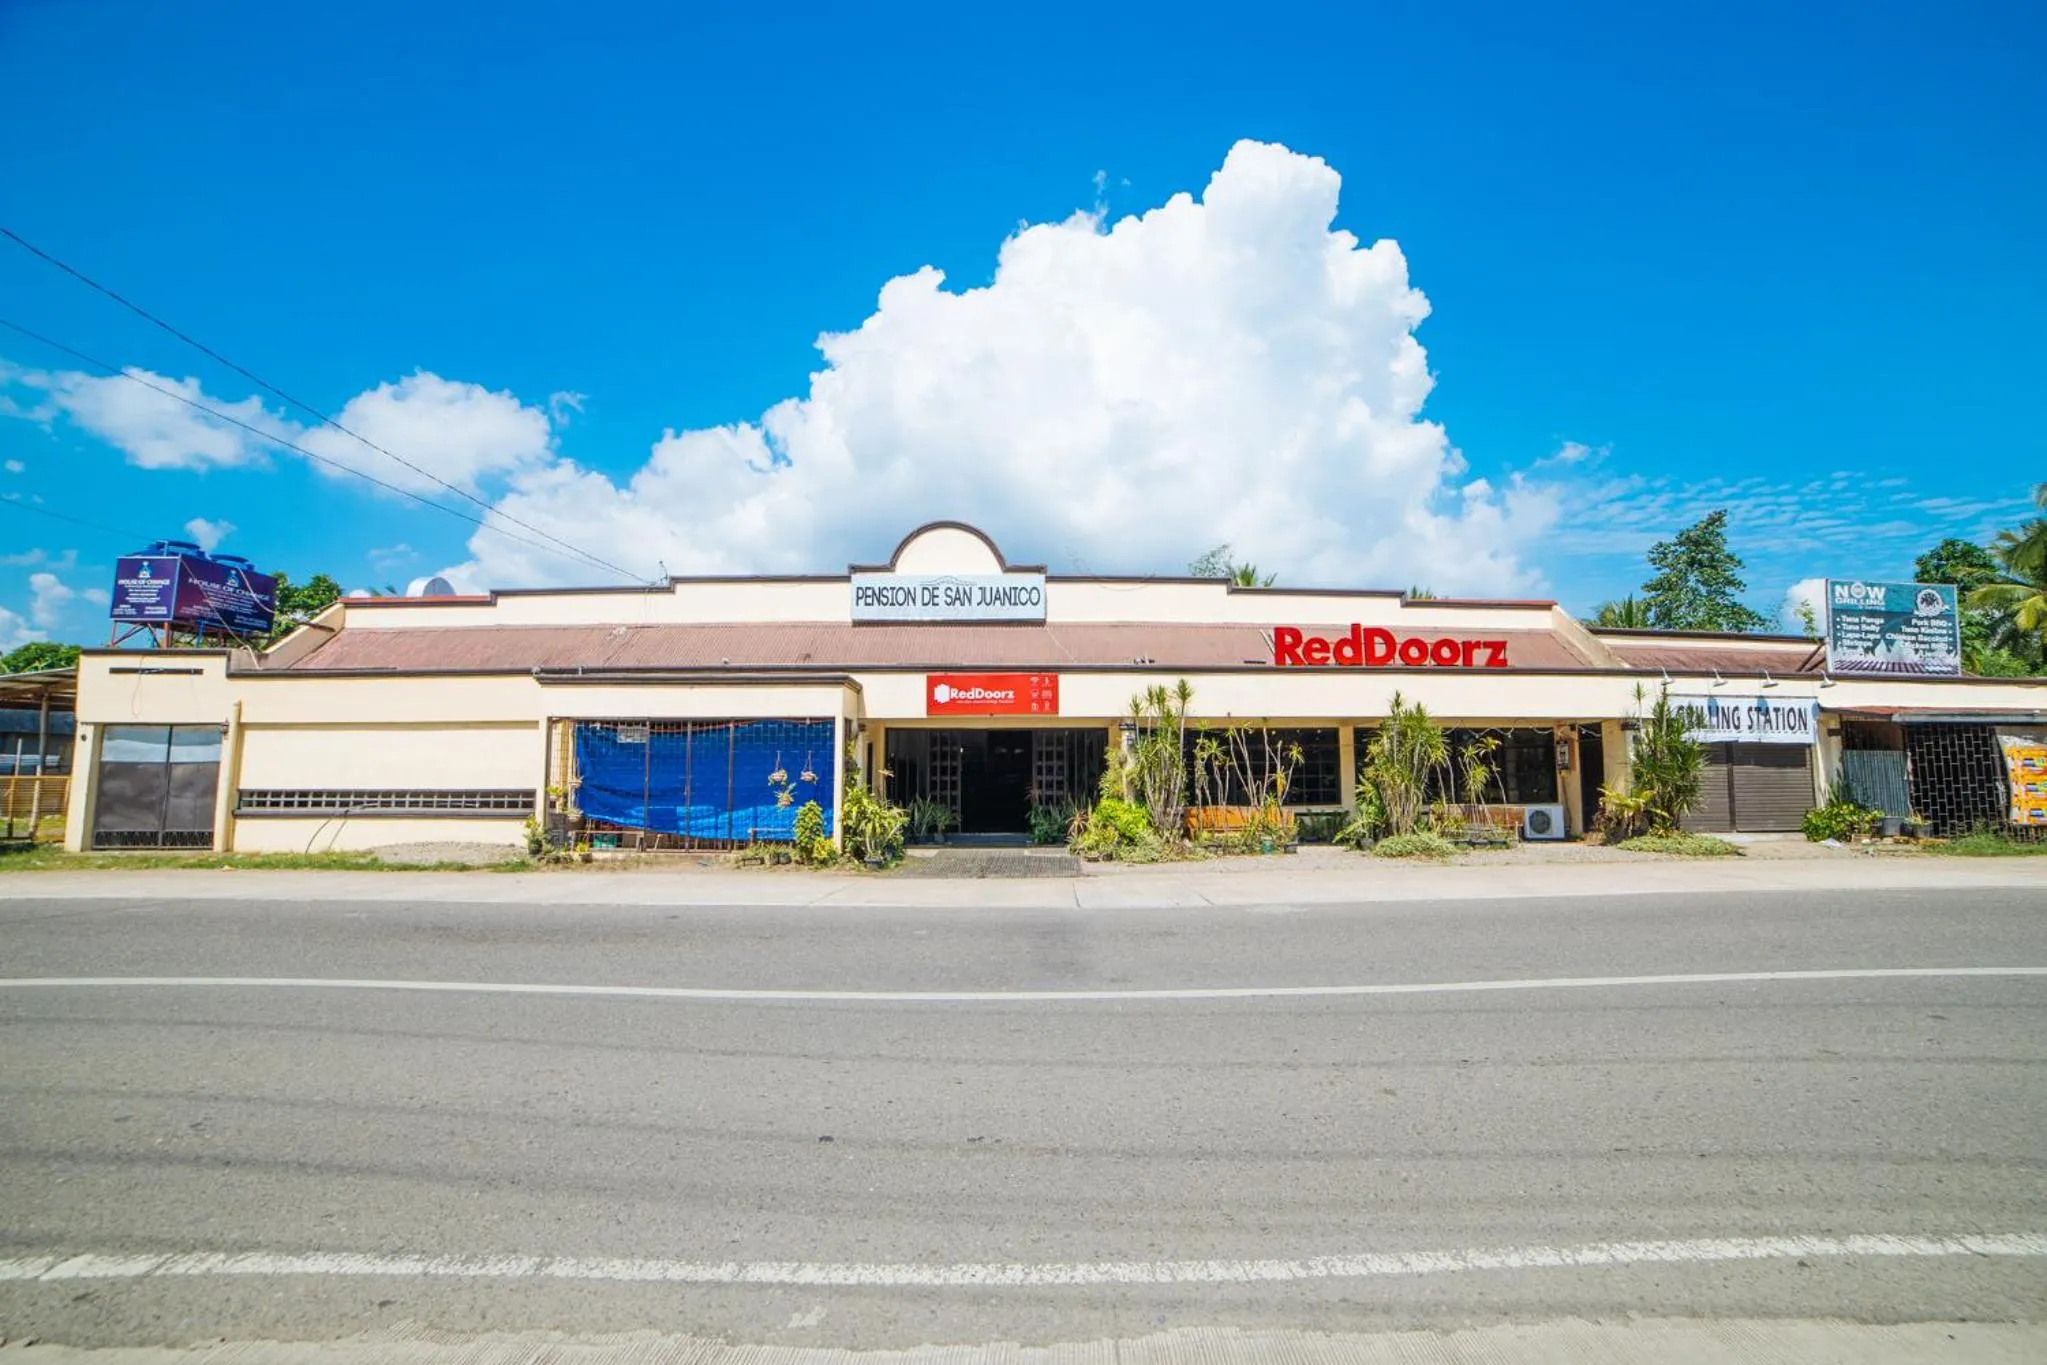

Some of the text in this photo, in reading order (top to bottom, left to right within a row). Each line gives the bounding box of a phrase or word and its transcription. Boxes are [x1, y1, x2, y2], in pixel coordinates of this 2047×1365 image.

[855, 586, 1040, 607] PENSION DE SAN JUANICO
[1835, 582, 1886, 599] NOW
[1273, 623, 1508, 667] RedDoorz
[950, 687, 1015, 699] RedDoorz
[1676, 705, 1808, 731] ILLING STATION
